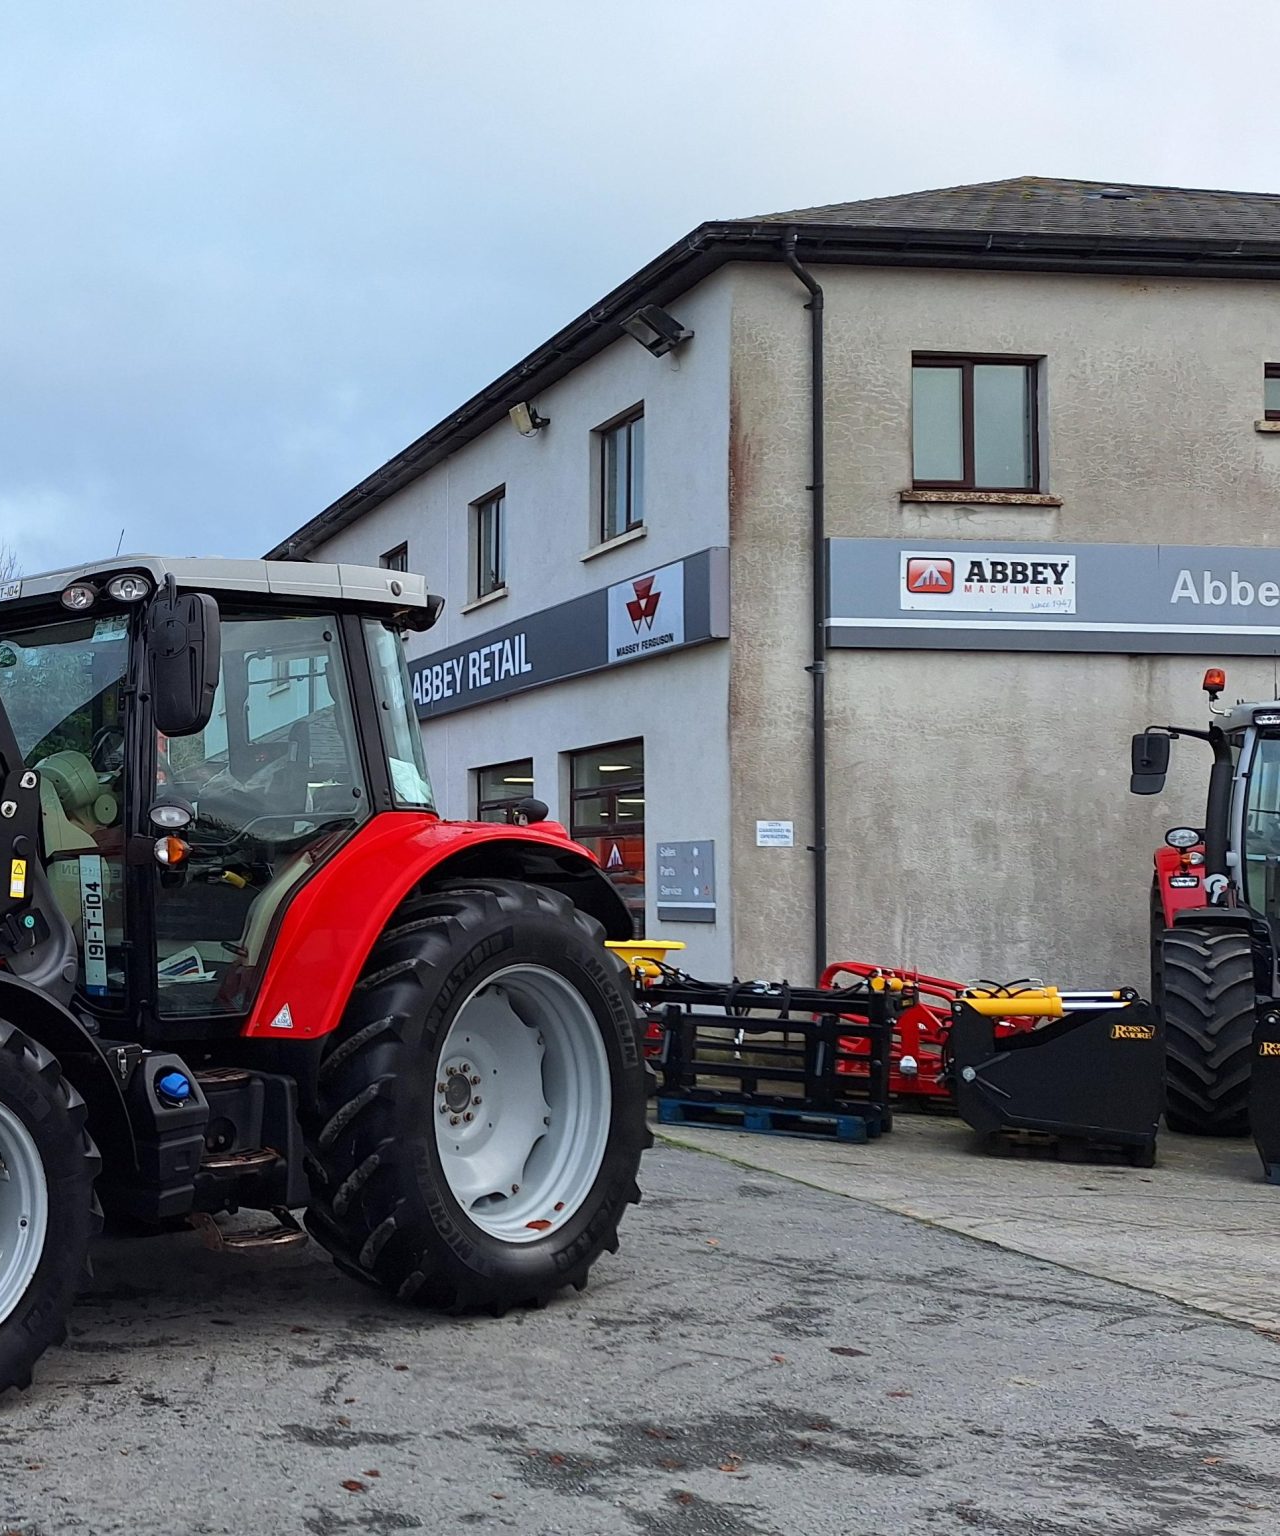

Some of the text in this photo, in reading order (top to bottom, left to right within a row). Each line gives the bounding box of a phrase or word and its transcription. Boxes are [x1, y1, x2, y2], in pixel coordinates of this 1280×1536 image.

[965, 561, 1069, 585] ABBEY
[1170, 569, 1280, 606] Abbe
[963, 584, 1064, 595] MACHINERY
[616, 633, 674, 657] MASSEY FERGUSON
[412, 633, 532, 705] ABBEY RETAIL
[660, 885, 682, 896] Service
[85, 881, 104, 961] 191-T-104
[585, 957, 637, 1064] MICHELIN
